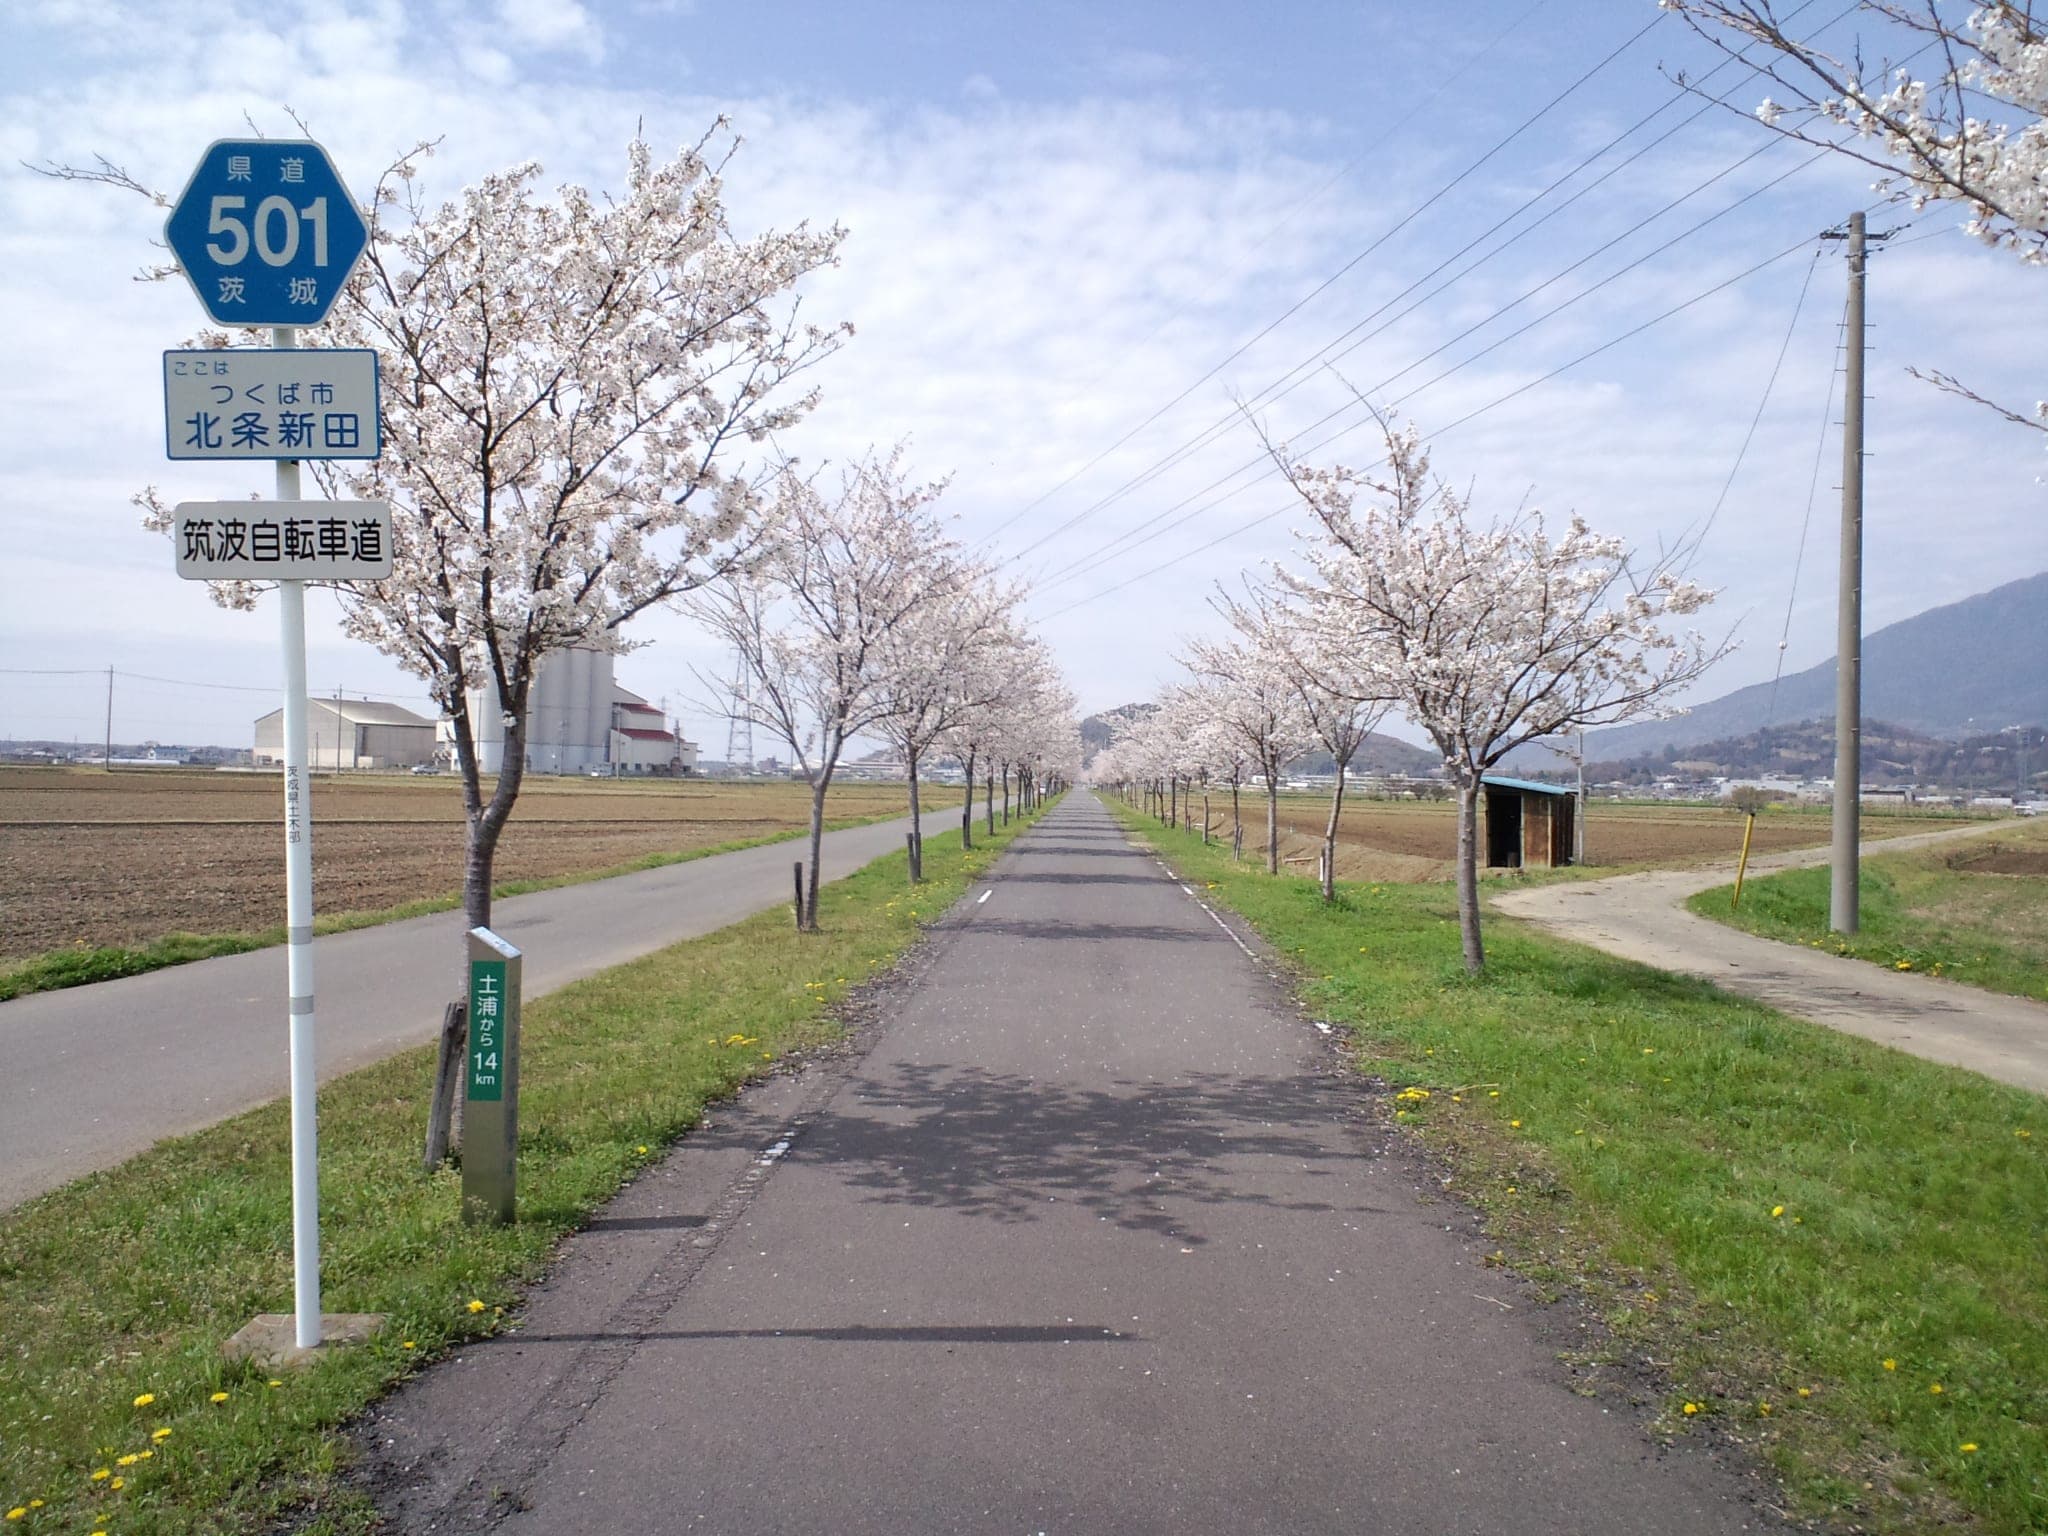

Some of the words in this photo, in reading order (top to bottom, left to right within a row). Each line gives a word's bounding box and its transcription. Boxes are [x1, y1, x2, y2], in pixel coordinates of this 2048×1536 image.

[227, 155, 305, 183] 県道
[206, 195, 329, 267] 501
[218, 276, 318, 305] 茨城
[174, 360, 229, 376] ここは
[210, 382, 334, 405] つくば市
[185, 410, 360, 449] 北条新田
[183, 517, 383, 562] 筑波自転車道
[477, 974, 499, 1047] 土浦から
[474, 1052, 498, 1070] 14
[475, 1073, 495, 1085] km
